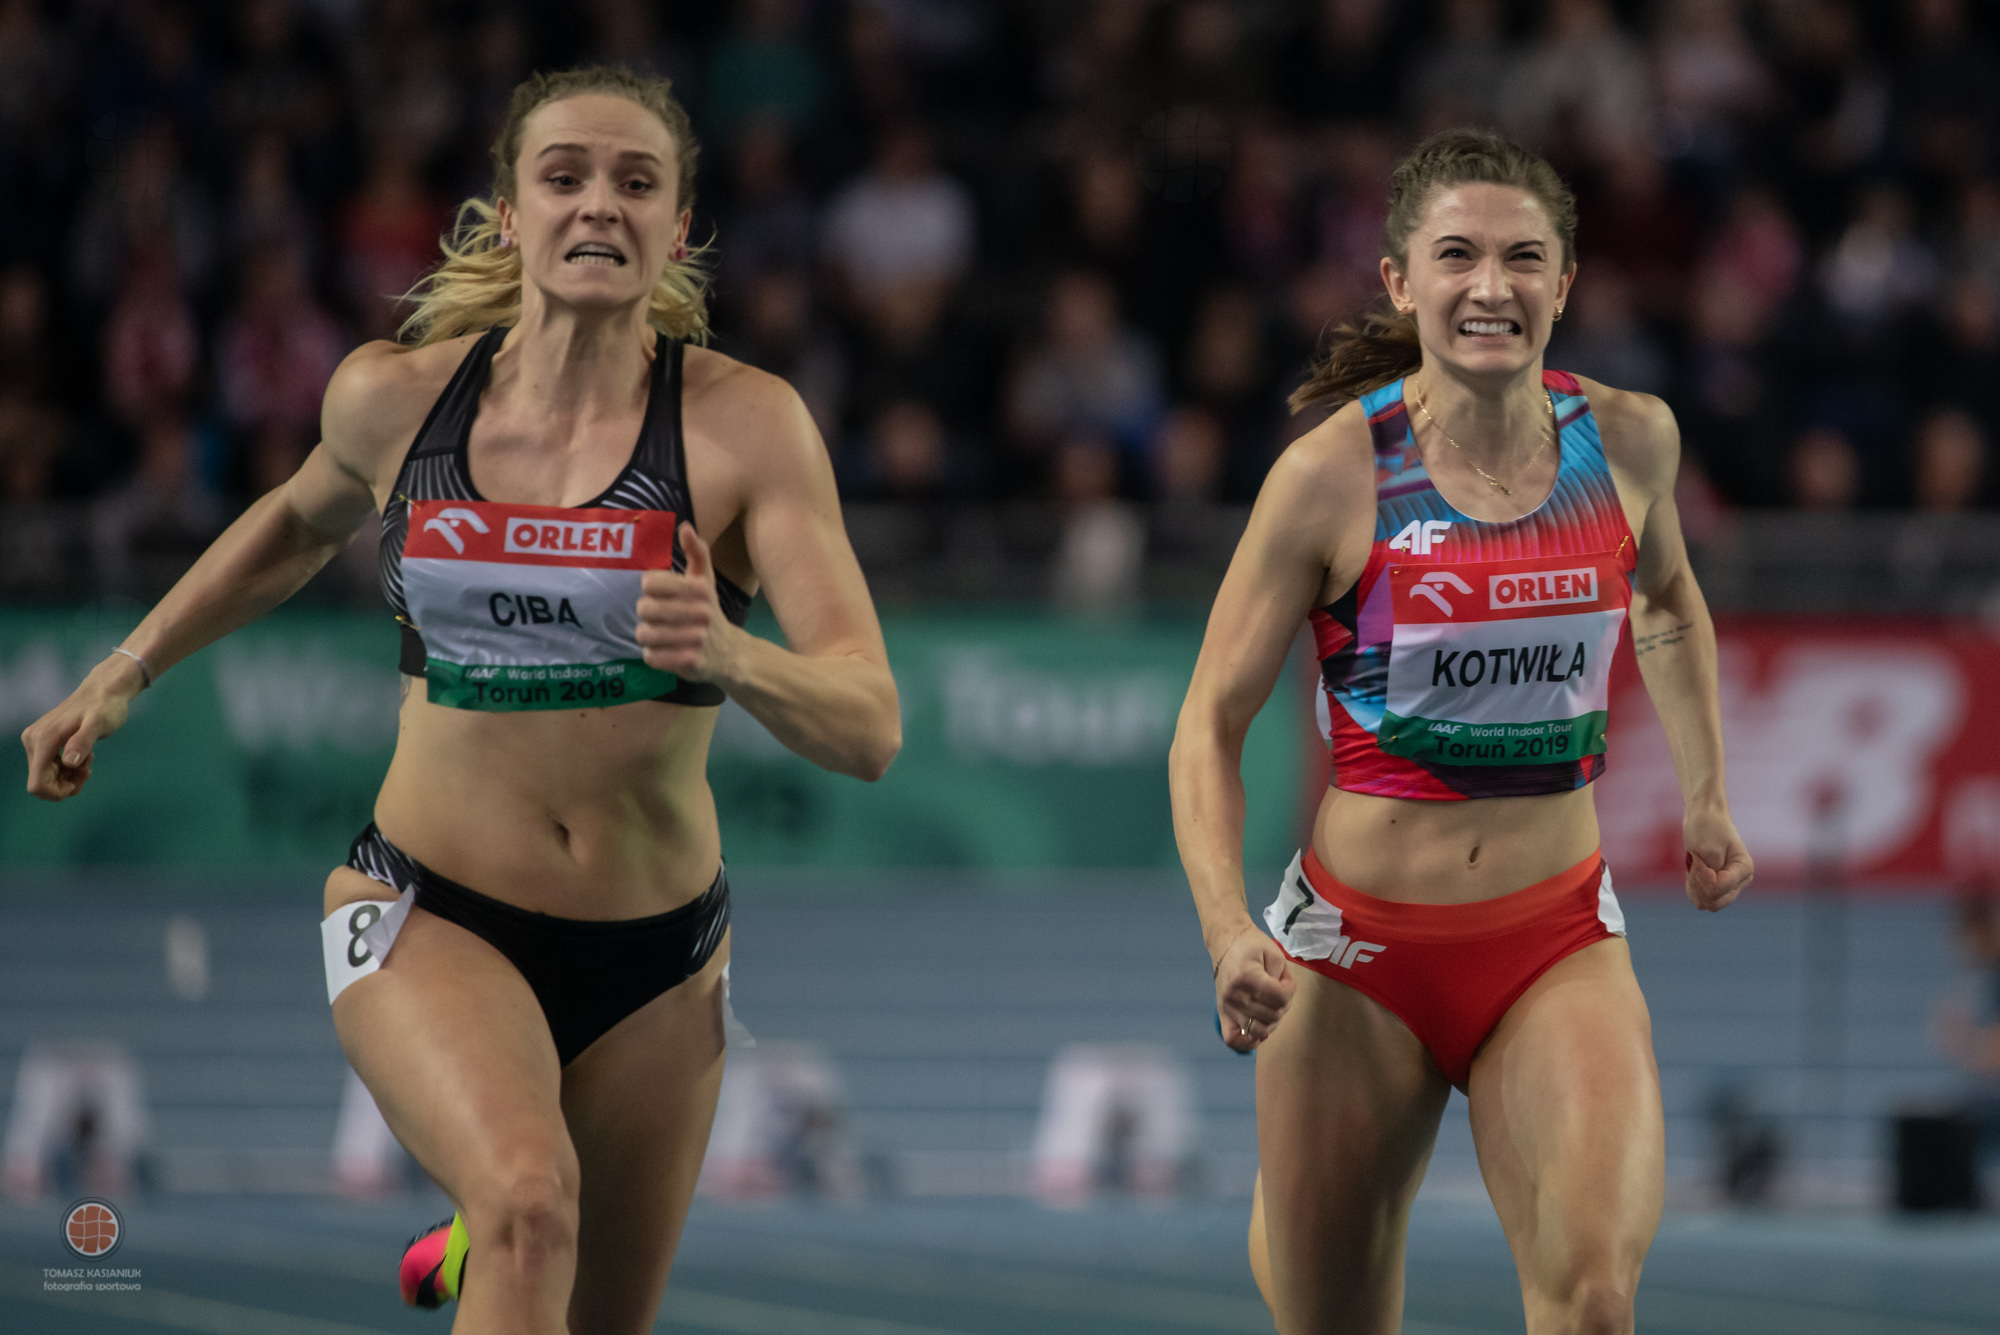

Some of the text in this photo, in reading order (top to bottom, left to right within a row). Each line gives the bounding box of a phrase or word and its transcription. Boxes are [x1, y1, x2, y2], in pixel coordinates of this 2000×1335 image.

[513, 523, 625, 552] ORLEN
[1389, 519, 1452, 555] 4F
[1495, 573, 1592, 604] ORLEN
[489, 592, 582, 628] CIBA
[507, 668, 546, 680] World
[550, 667, 594, 679] Indoor
[597, 664, 625, 677] Tour
[1431, 641, 1585, 688] KOTWIŁA
[473, 677, 625, 703] Toruń 2019
[1428, 722, 1573, 737] IAAF World Indoor Tour
[1434, 734, 1569, 759] Toruń 2019
[1282, 875, 1315, 936] 7
[347, 904, 382, 968] 8
